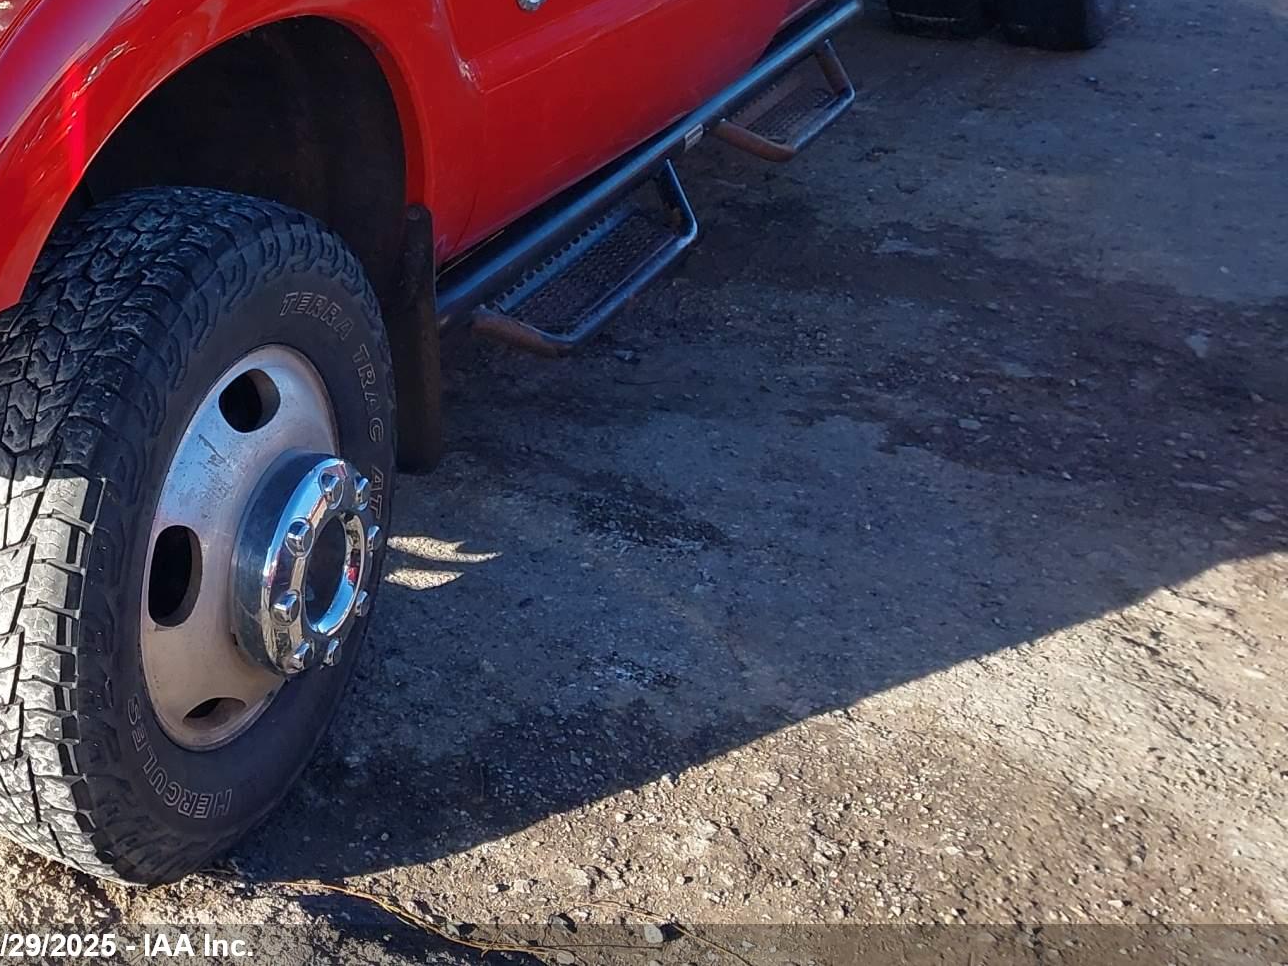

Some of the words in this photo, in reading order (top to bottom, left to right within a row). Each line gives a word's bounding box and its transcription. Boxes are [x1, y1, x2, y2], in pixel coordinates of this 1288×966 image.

[280, 291, 354, 341] TERRA
[351, 342, 385, 444] TRAC
[127, 692, 233, 819] HERCULES
